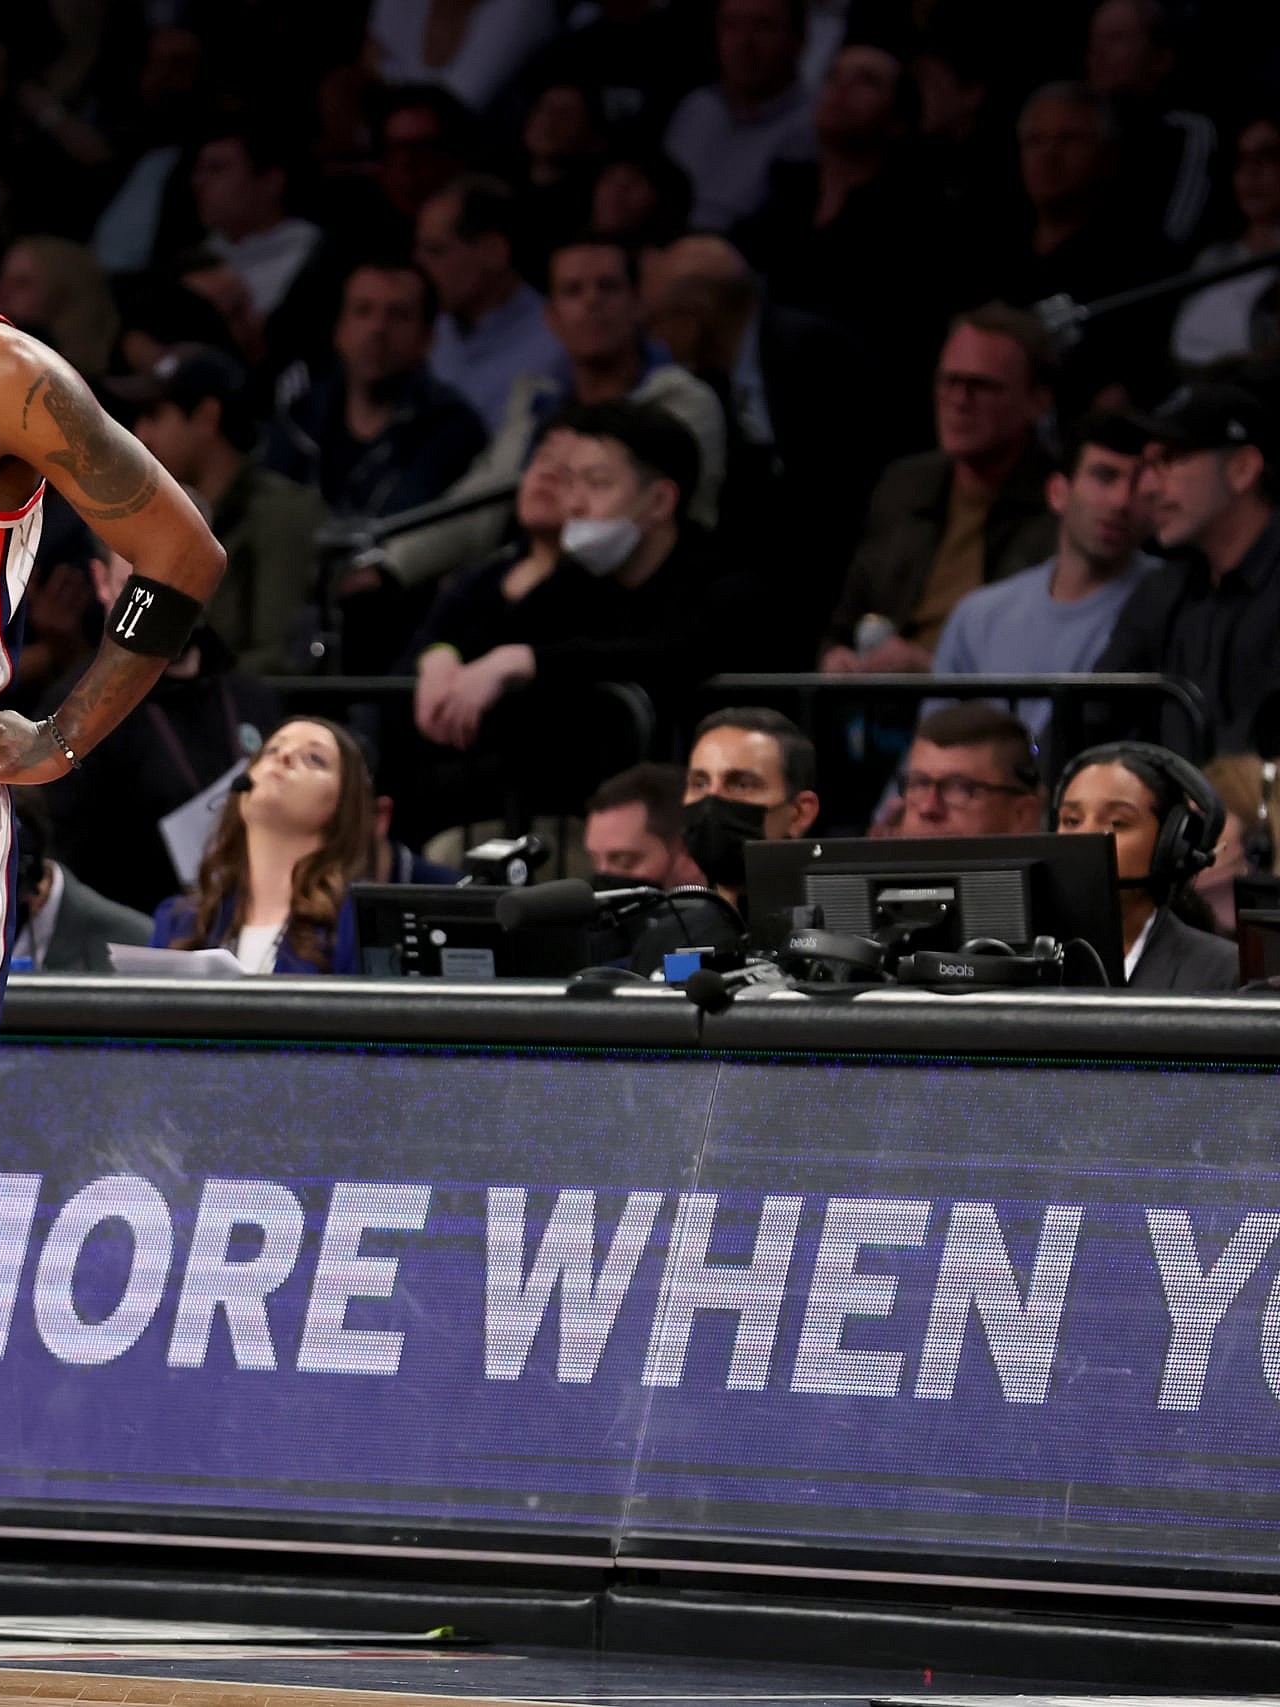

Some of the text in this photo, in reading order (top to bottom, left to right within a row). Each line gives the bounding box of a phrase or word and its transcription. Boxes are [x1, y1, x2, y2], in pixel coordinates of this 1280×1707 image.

[938, 961, 975, 977] beats
[484, 1186, 1085, 1406] WHEN
[1144, 1207, 1280, 1412] Y
